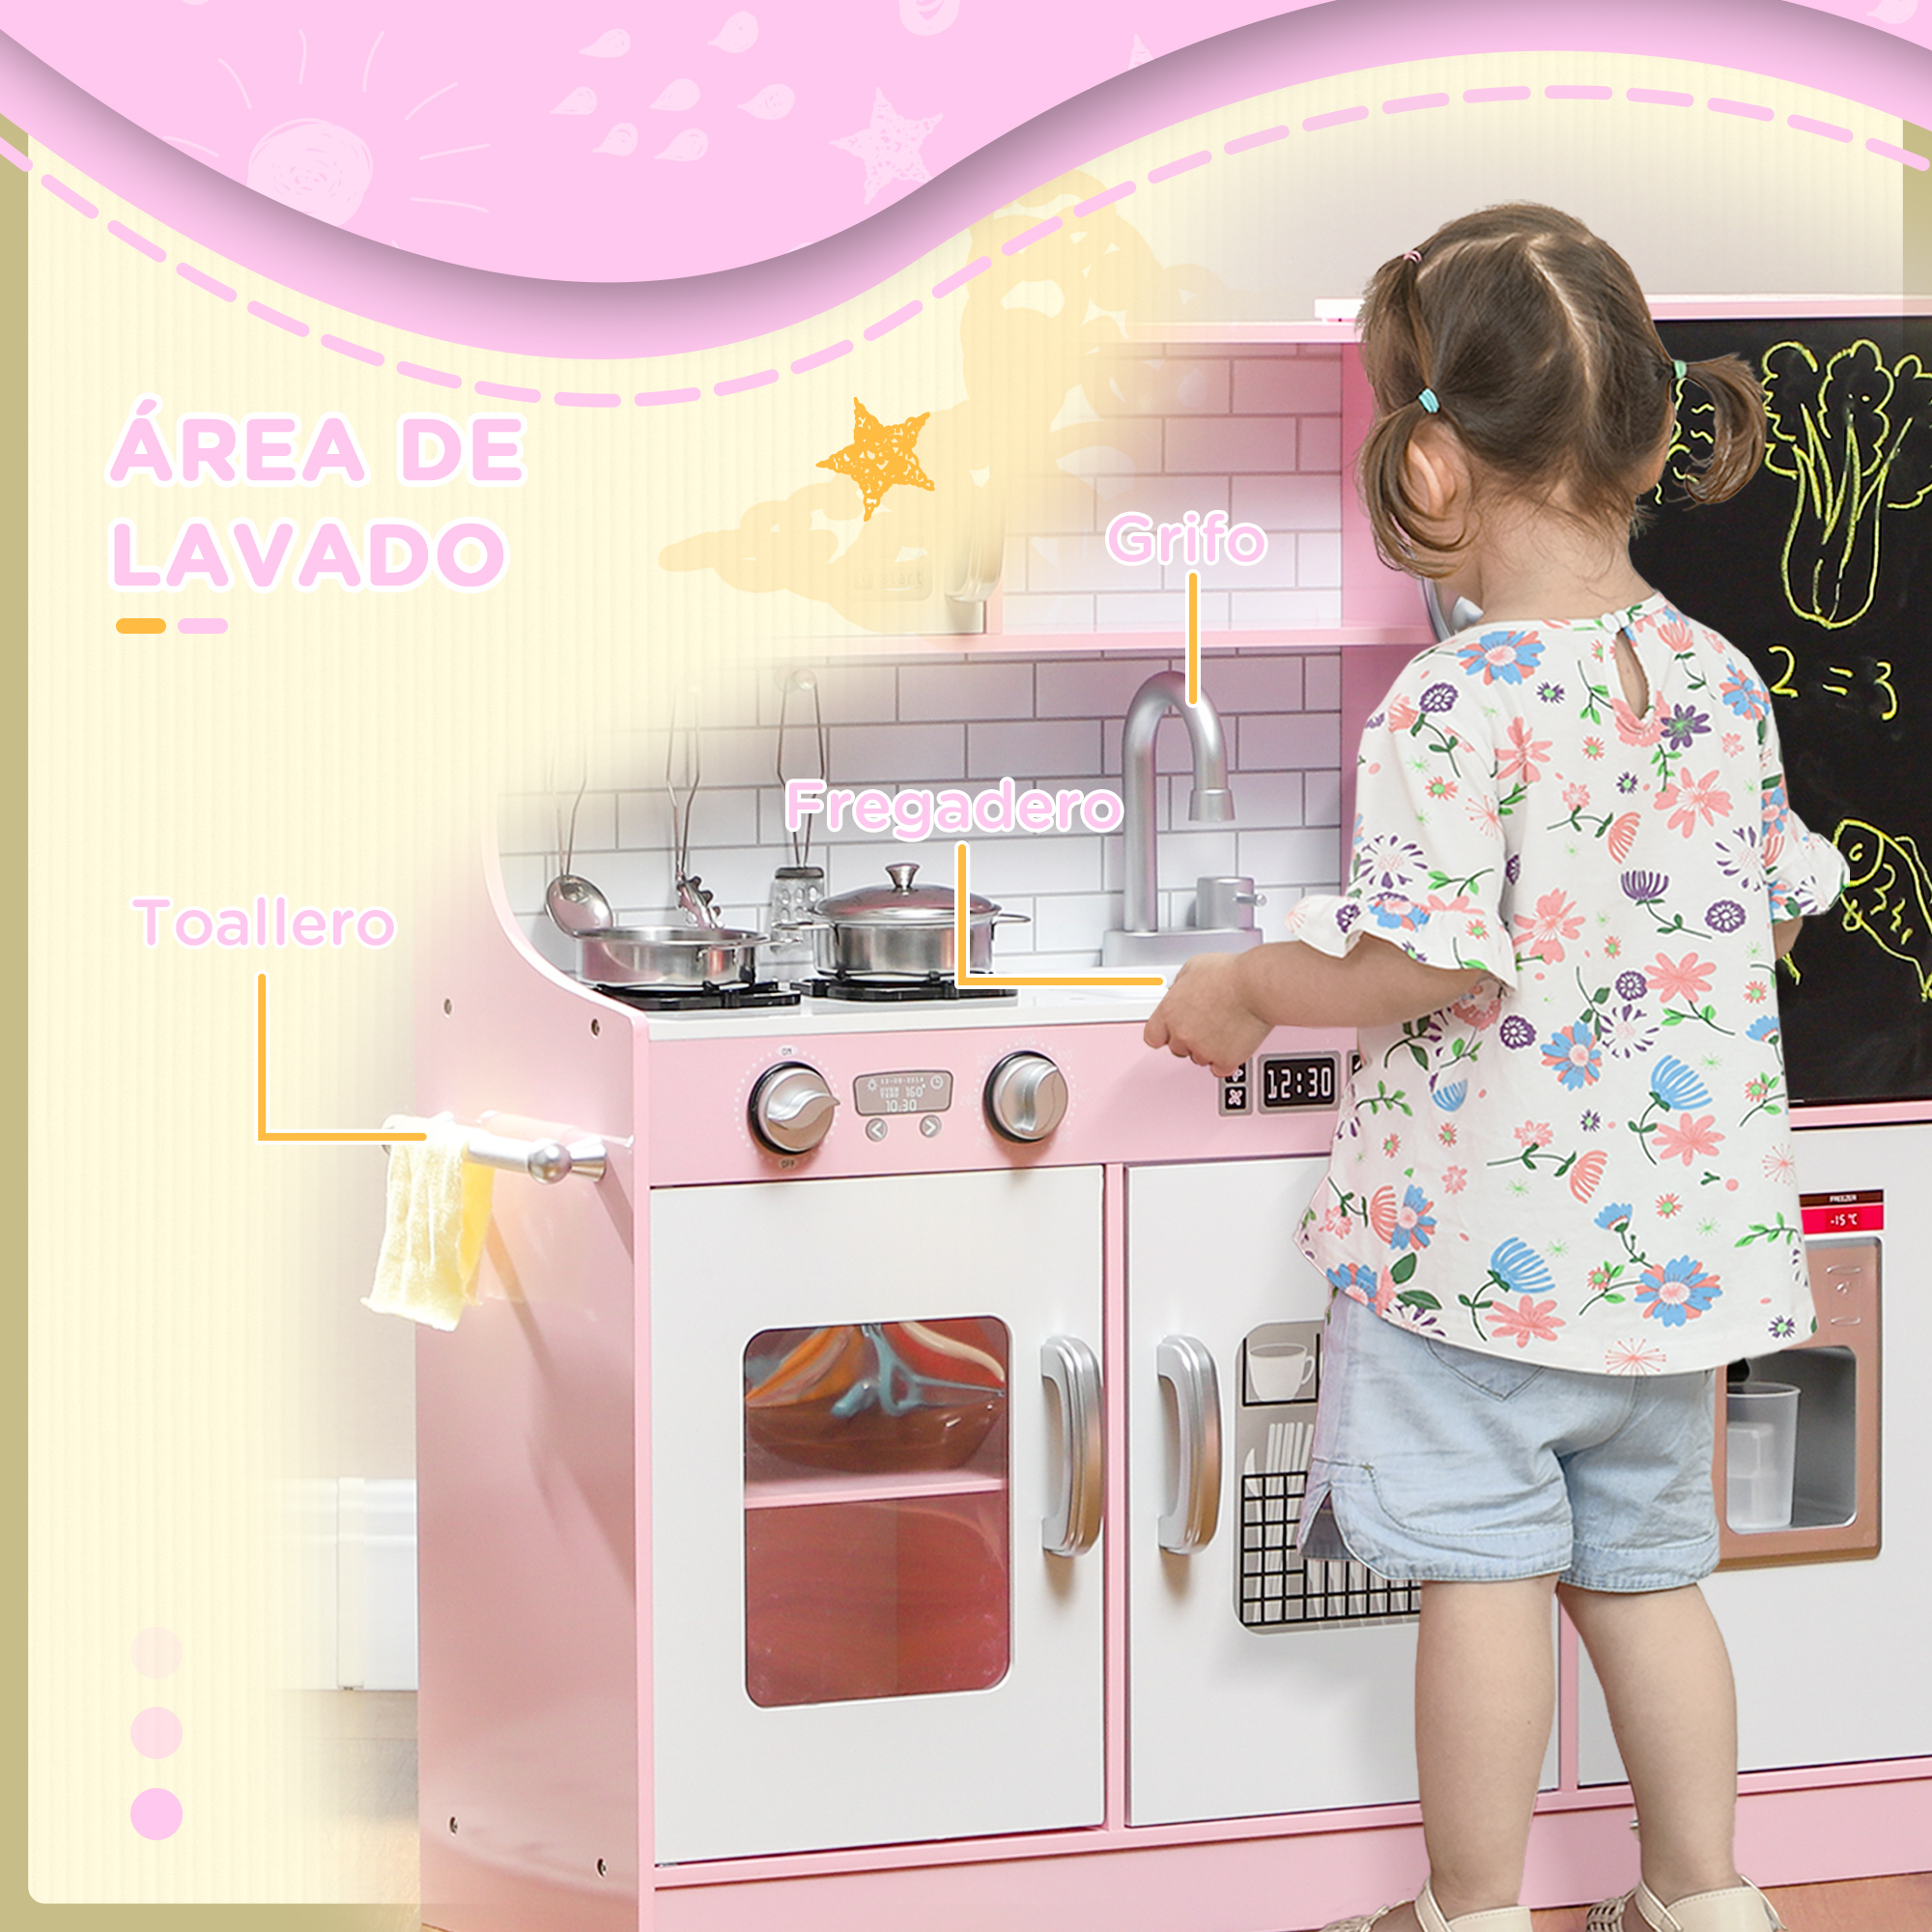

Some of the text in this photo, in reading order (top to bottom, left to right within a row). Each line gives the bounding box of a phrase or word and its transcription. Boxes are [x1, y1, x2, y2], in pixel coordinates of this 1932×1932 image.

[1768, 645, 1799, 698] 2
[1874, 661, 1899, 722] 3
[1267, 1065, 1332, 1100] 12:30
[886, 1098, 918, 1113] 10:30
